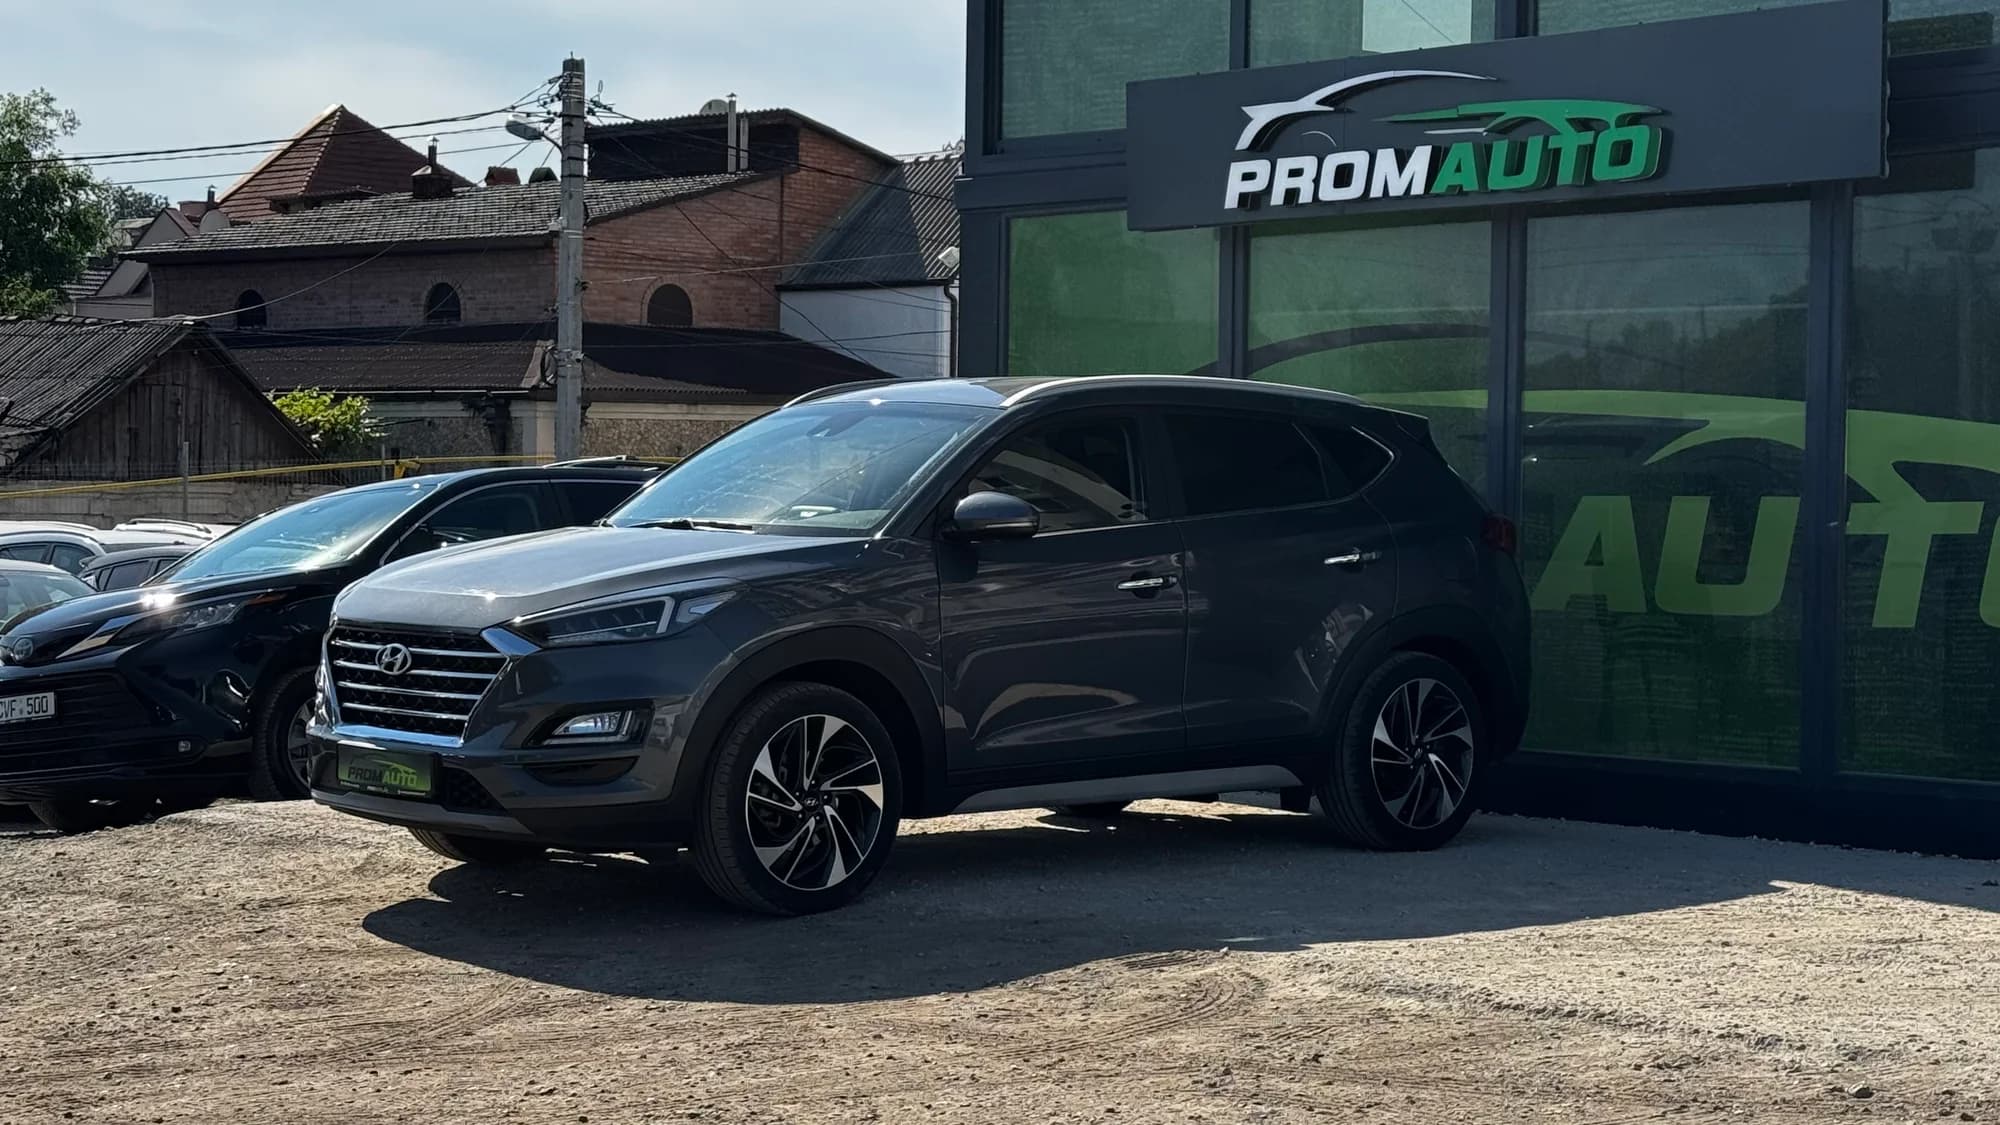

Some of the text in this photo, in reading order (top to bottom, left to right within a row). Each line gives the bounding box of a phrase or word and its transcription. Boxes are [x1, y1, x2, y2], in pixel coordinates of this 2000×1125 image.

[1224, 125, 1660, 209] PROMAUTO
[1530, 496, 2000, 628] AUT
[26, 695, 49, 715] 500
[347, 766, 417, 788] PROMAUTO
